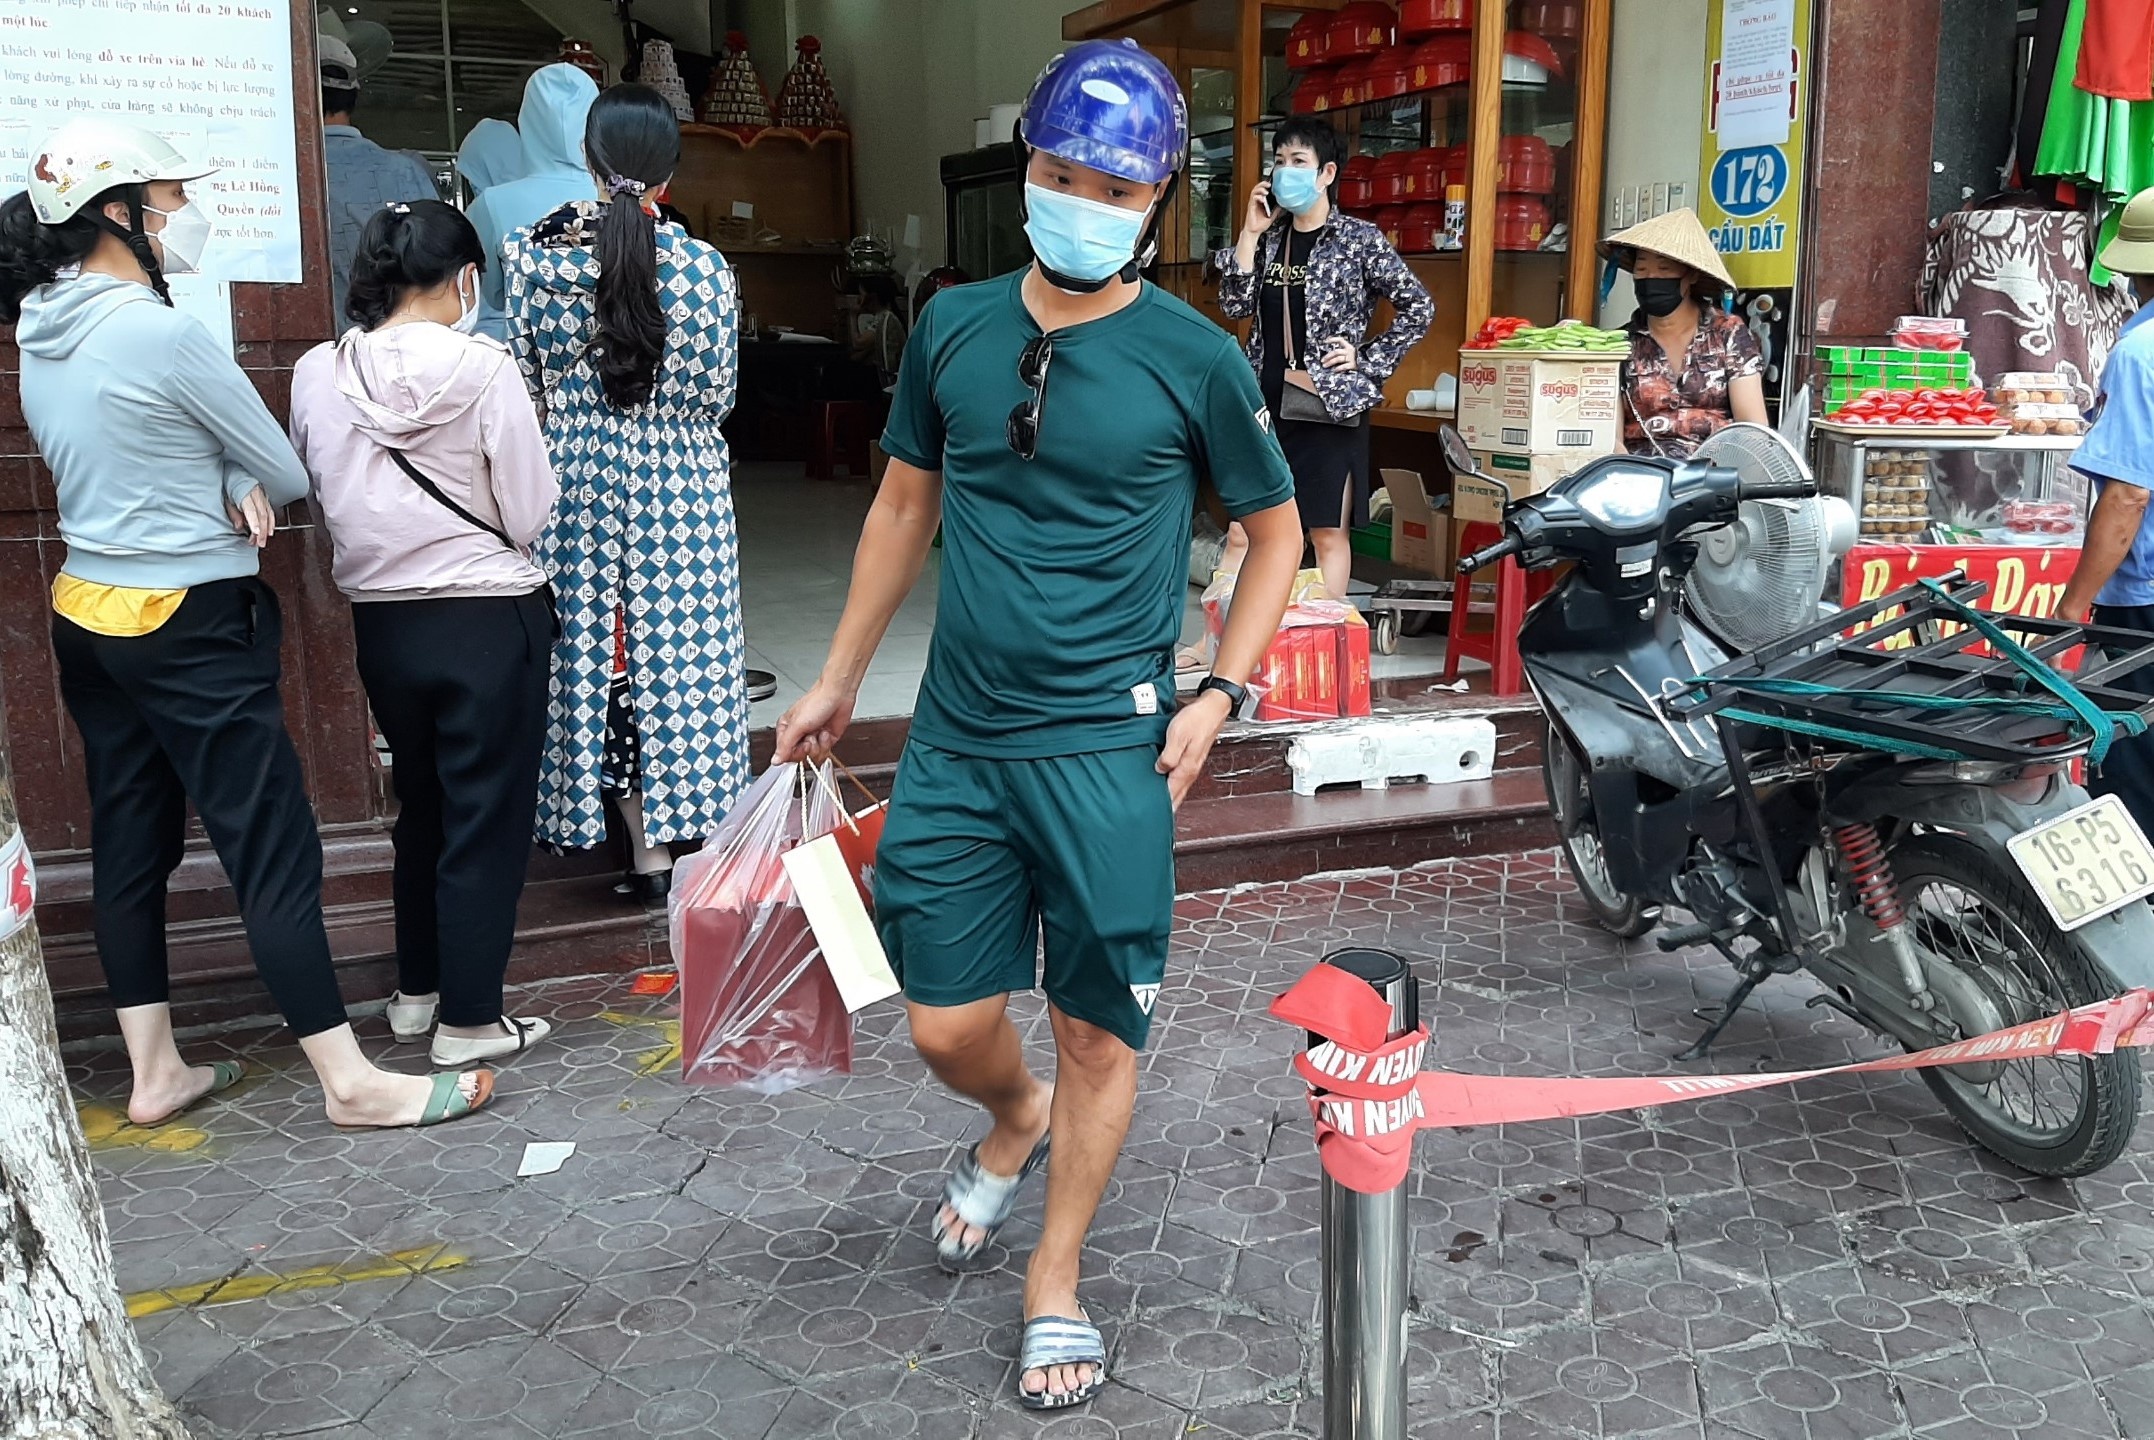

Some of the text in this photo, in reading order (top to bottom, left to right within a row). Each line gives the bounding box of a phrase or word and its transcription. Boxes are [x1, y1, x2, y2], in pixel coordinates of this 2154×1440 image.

[2, 15, 26, 29] một
[218, 4, 232, 16] 20
[237, 6, 272, 19] khách
[2, 44, 37, 58] khách
[43, 48, 61, 59] vui
[119, 54, 132, 63] xe
[138, 53, 163, 65] trên
[215, 55, 237, 70] Nếu
[261, 62, 275, 72] xe
[79, 73, 98, 86] khi
[127, 78, 139, 88] ra
[244, 82, 276, 98] lượng
[128, 100, 156, 116] hàng
[180, 102, 213, 118] không
[250, 106, 277, 119] trách
[209, 156, 236, 169] thêm
[231, 180, 247, 192] Lê
[250, 178, 281, 196] Hồng
[1722, 153, 1775, 206] 172
[217, 201, 255, 217] Quyền
[1708, 215, 1786, 253] CẦU ĐẤT
[2030, 809, 2122, 872] 16-P5
[2056, 849, 2148, 915] 6316
